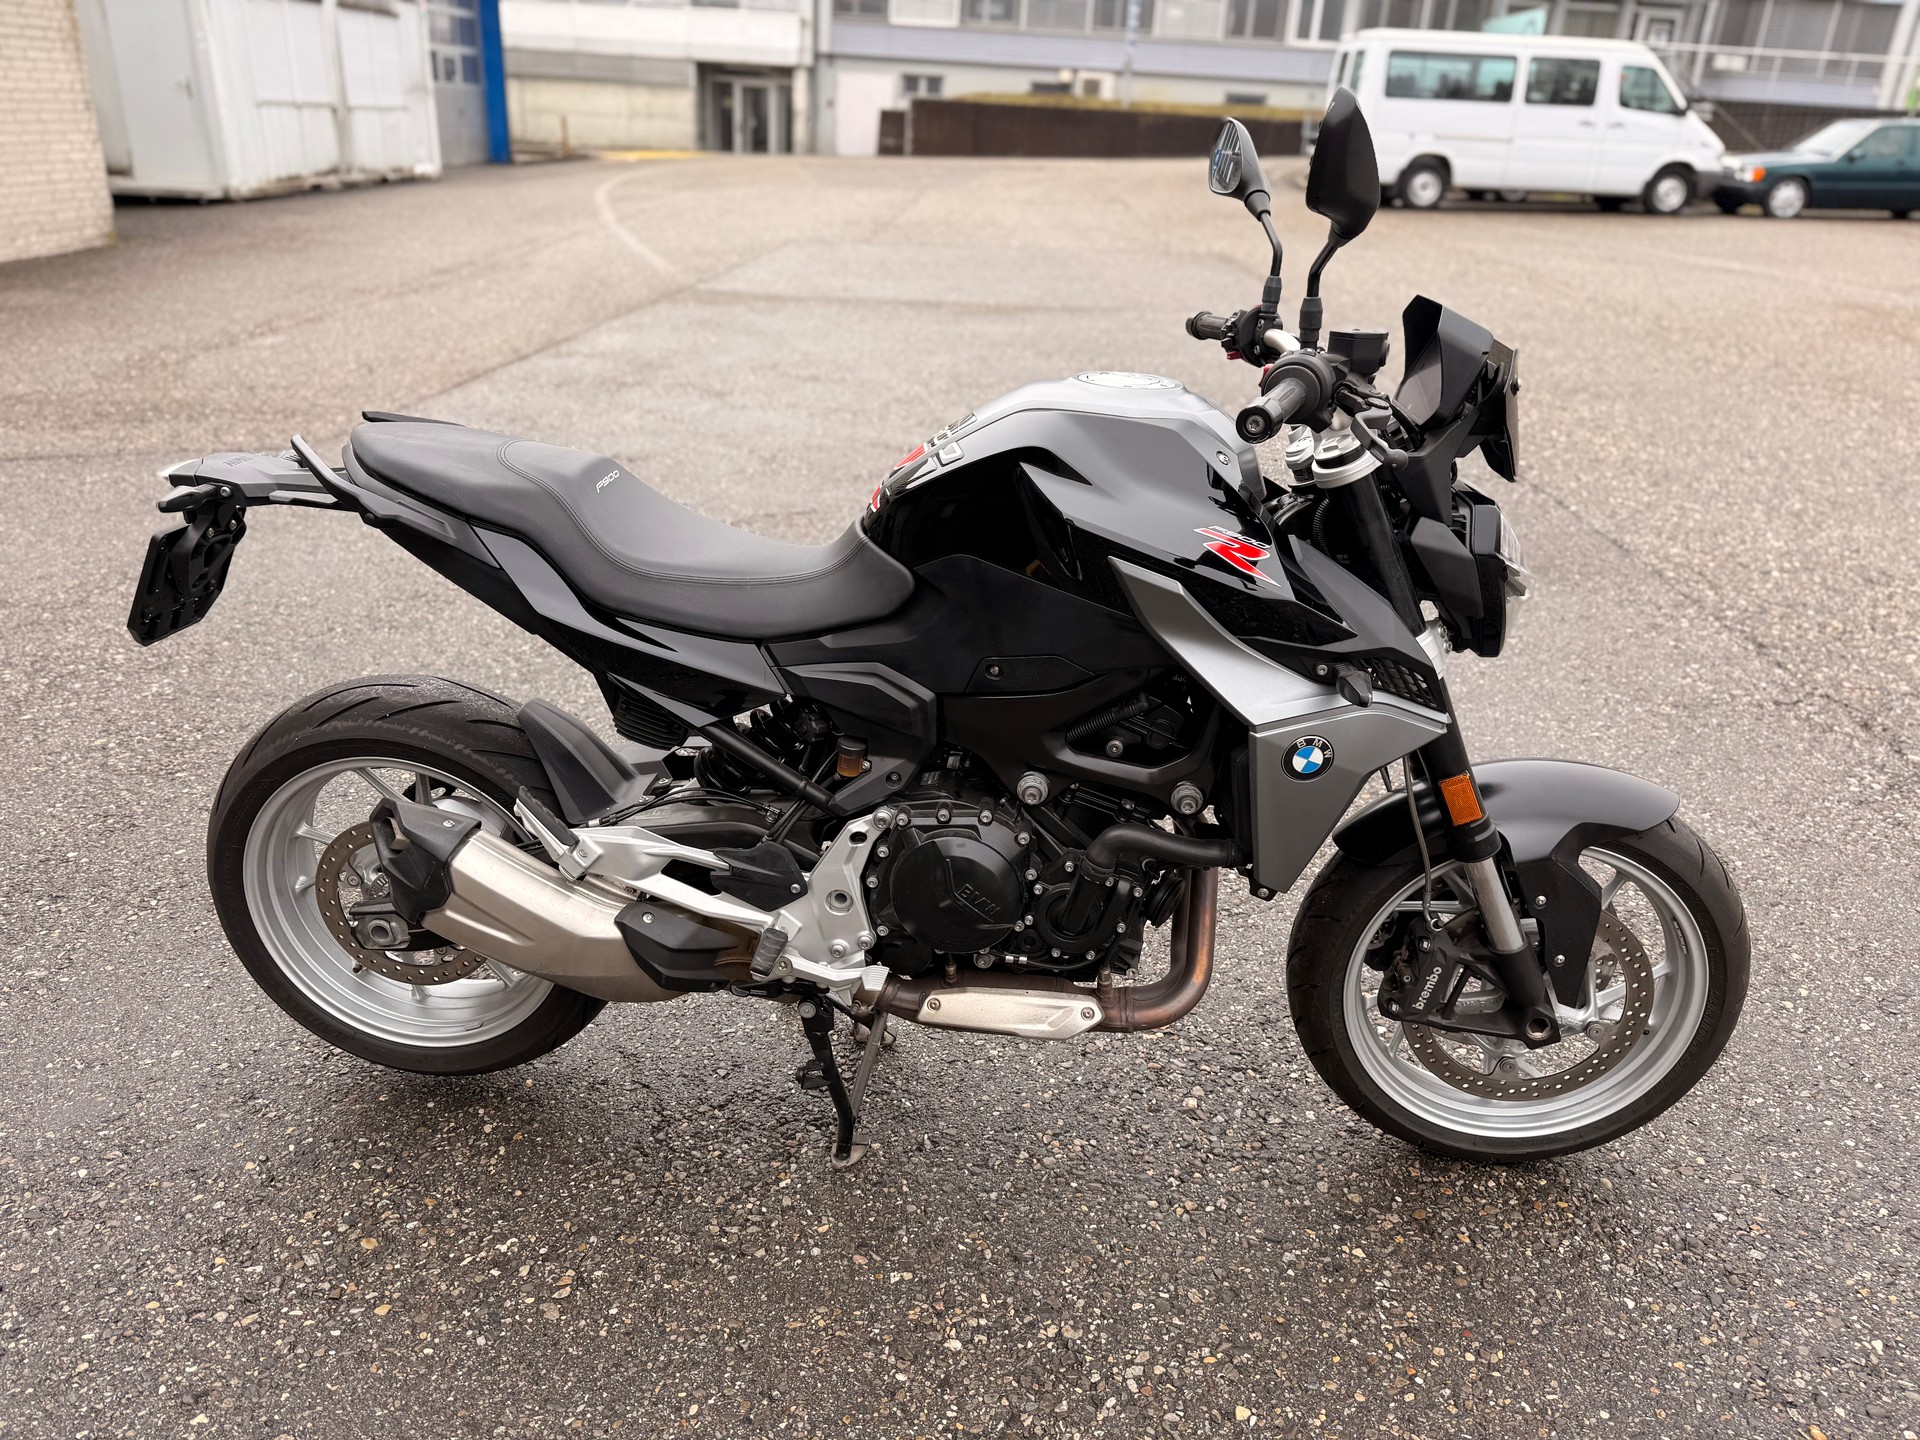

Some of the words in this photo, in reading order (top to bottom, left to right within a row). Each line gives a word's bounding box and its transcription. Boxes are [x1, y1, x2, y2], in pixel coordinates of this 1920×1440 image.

[595, 469, 620, 494] F900
[1193, 527, 1282, 588] R
[1296, 738, 1333, 758] BMW
[1412, 966, 1442, 1010] brembo
